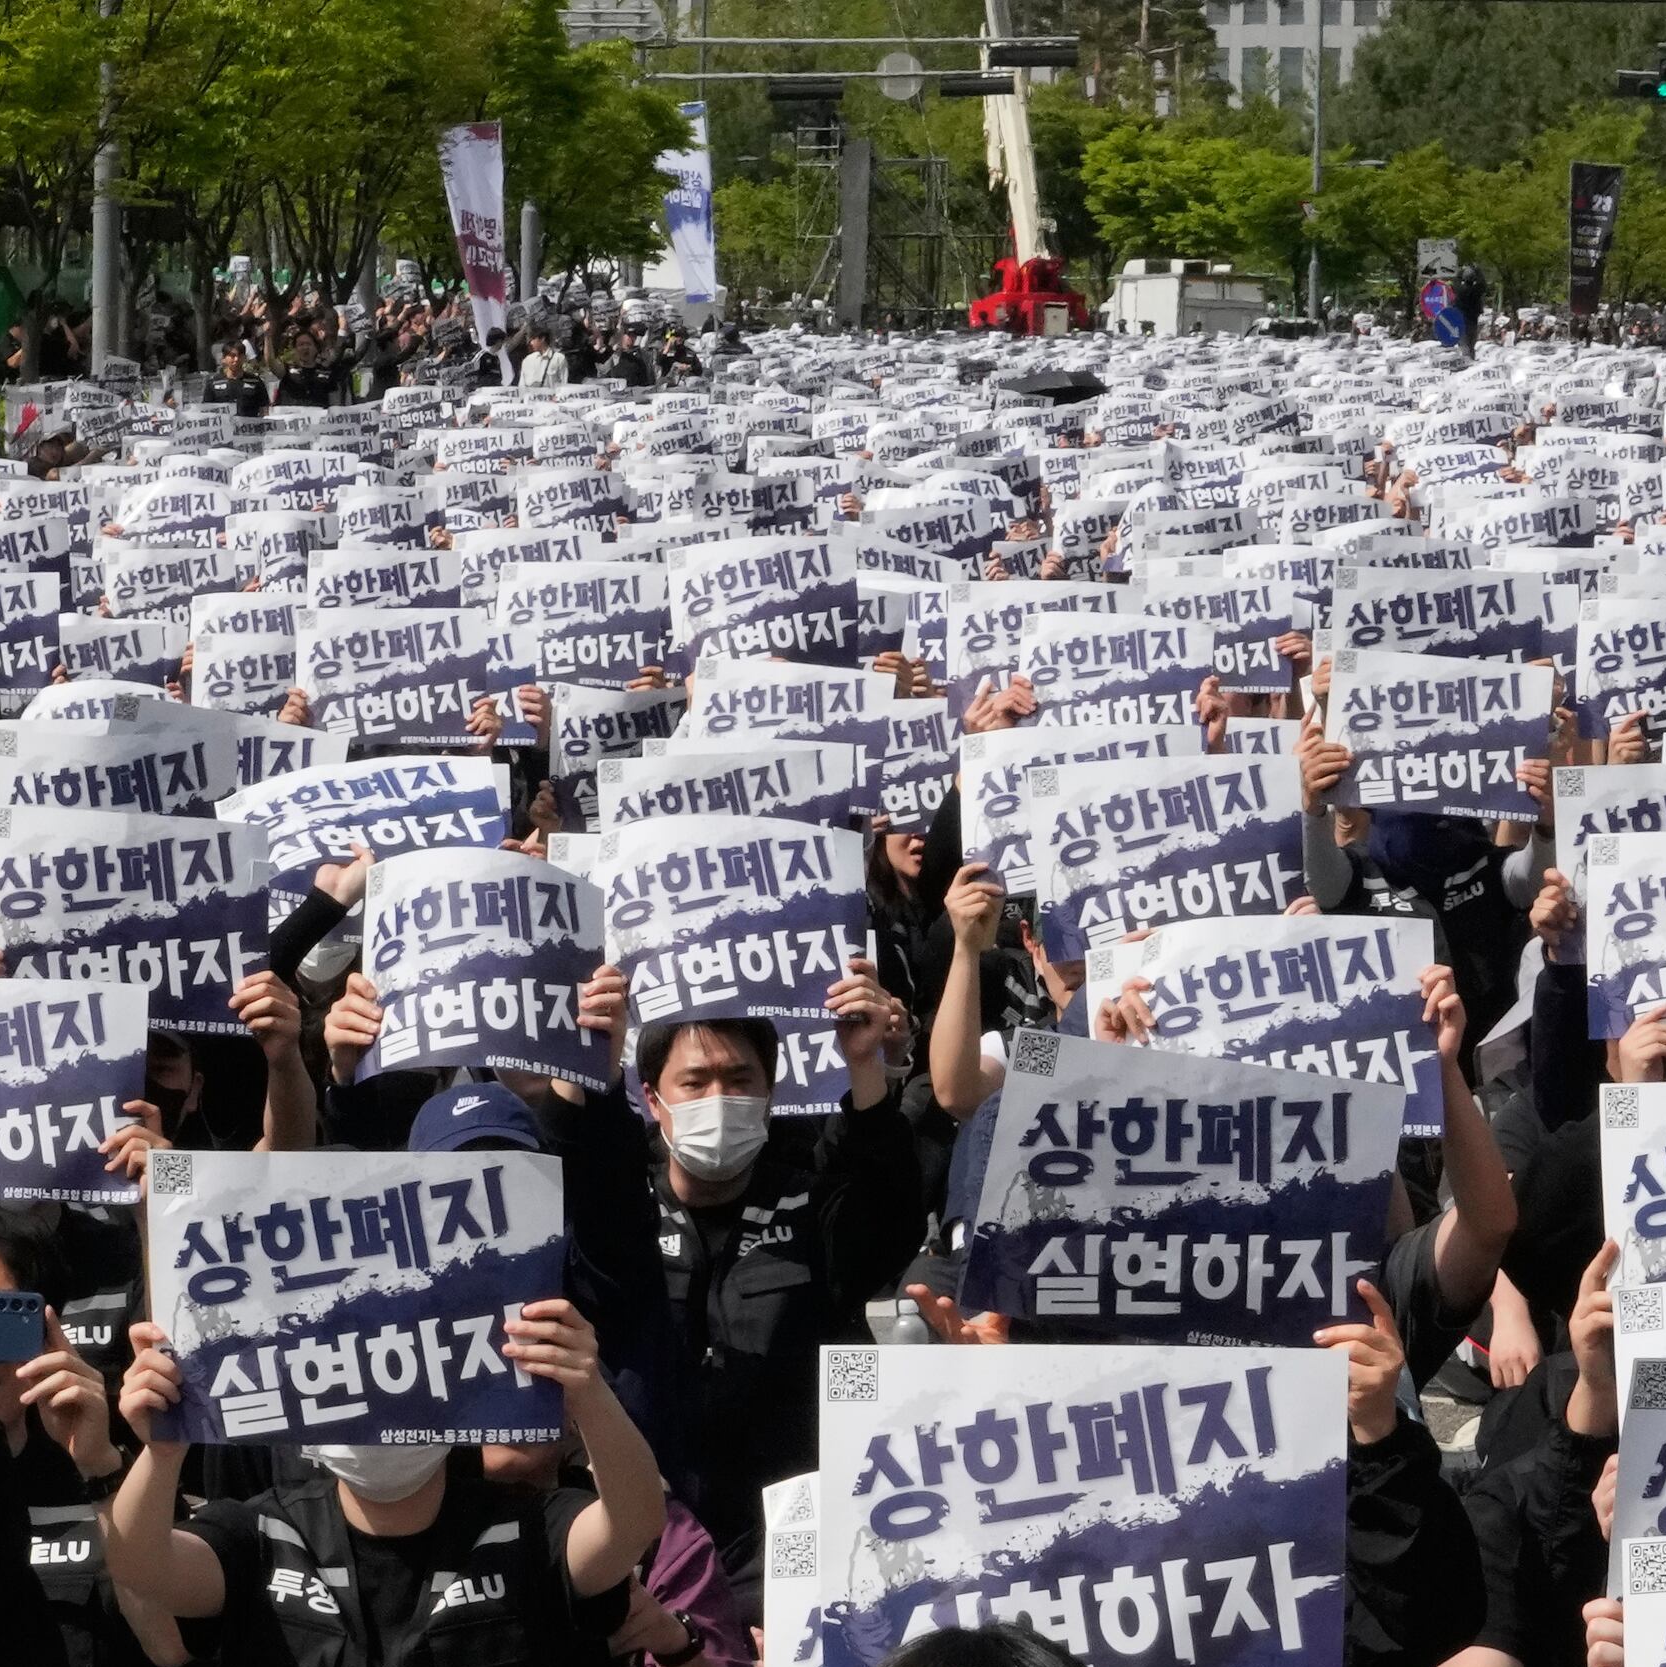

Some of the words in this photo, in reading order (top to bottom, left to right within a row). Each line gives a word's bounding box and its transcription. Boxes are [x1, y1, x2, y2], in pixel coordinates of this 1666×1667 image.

[445, 433, 508, 459] 상한폐지
[1169, 447, 1250, 484] 상한폐지
[525, 477, 612, 519] 상한폐지
[702, 480, 799, 517] 상한폐지
[1482, 501, 1583, 547] 상한폐지
[111, 560, 221, 605] 상한폐지
[508, 575, 641, 626] 상한폐지
[682, 543, 830, 611] 상한폐지
[1346, 579, 1515, 644] 상한폐지
[309, 616, 462, 677] 상한폐지
[1027, 628, 1189, 684] 상한폐지
[322, 679, 483, 737] 실현하자
[1343, 668, 1522, 731] 상한폐지
[243, 761, 457, 830] 상한폐지
[1355, 745, 1535, 801] 실현하자
[1051, 774, 1265, 865] 상한폐지
[605, 834, 835, 930] 상한폐지
[1077, 851, 1305, 939] 실현하자
[369, 874, 578, 985] 상한폐지
[632, 922, 863, 1022] 실현하자
[1148, 929, 1396, 1038] 상한폐지
[378, 974, 592, 1064] 실현하자
[747, 1005, 818, 1019] 삼성전자노동조합
[456, 1096, 479, 1110] NIKE
[485, 1054, 555, 1078] 삼성전자노동조합
[557, 1069, 607, 1092] 공동투쟁본부
[1021, 1096, 1348, 1187] 상한폐지
[2, 1187, 81, 1202] 삼성전자노동조합
[82, 1188, 138, 1204] 공동투쟁본부
[176, 1166, 508, 1305] 상한폐지
[1028, 1233, 1378, 1316] 실현하자
[206, 1301, 533, 1440] 실현하자
[380, 1426, 482, 1445] 삼성전자노동조합
[484, 1426, 562, 1445] 공동투쟁본부
[853, 1366, 1280, 1538] 상한폐지
